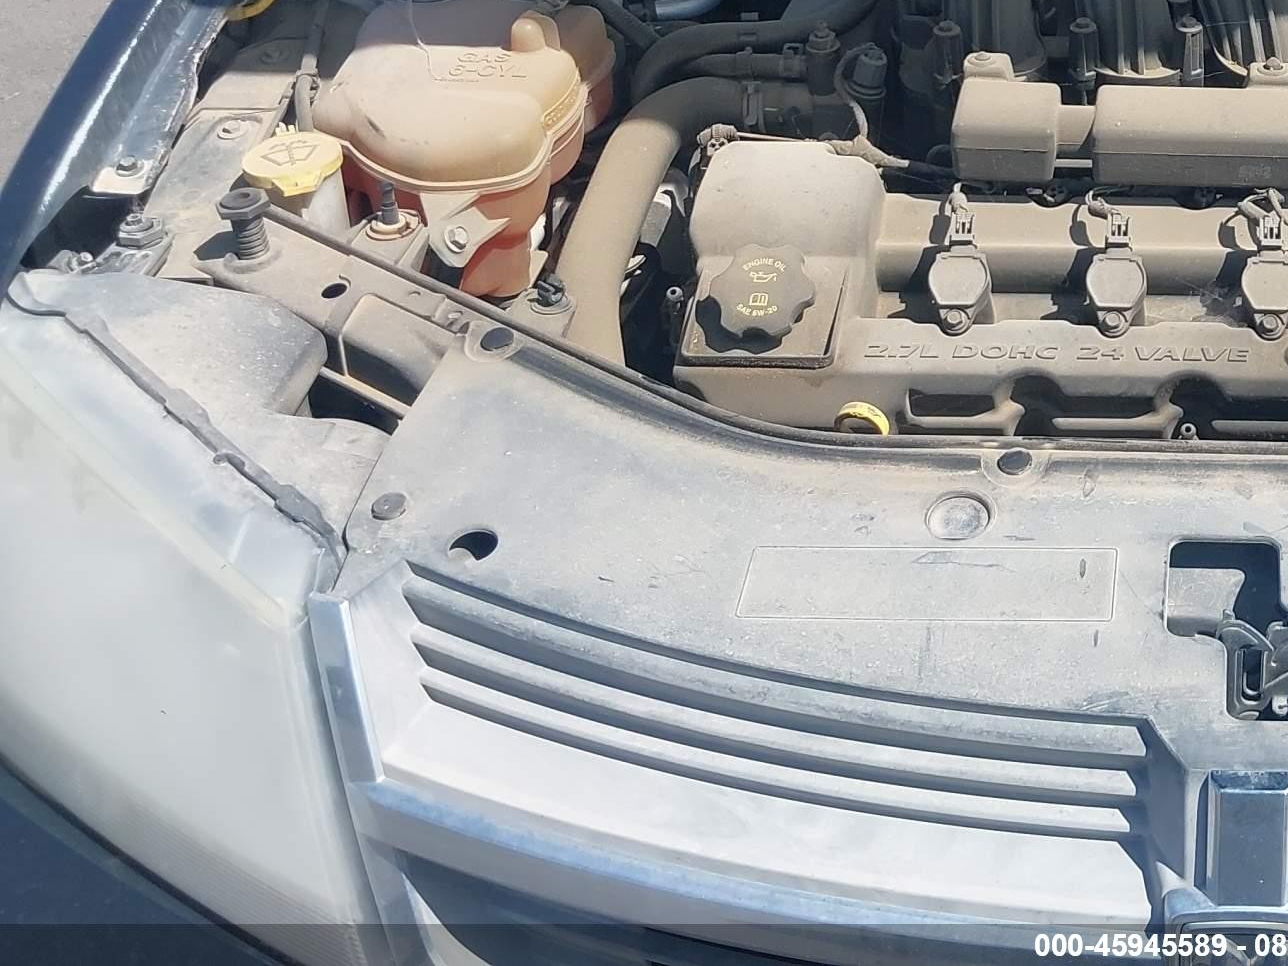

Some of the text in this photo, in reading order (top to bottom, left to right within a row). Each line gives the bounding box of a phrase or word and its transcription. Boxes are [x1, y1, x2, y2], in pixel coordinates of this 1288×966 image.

[456, 51, 512, 63] GAS
[742, 257, 787, 273] ENGINE OIL
[736, 303, 779, 317] SAE 5W-20
[864, 344, 1250, 363] 2.7L DOHC 24 VALVE
